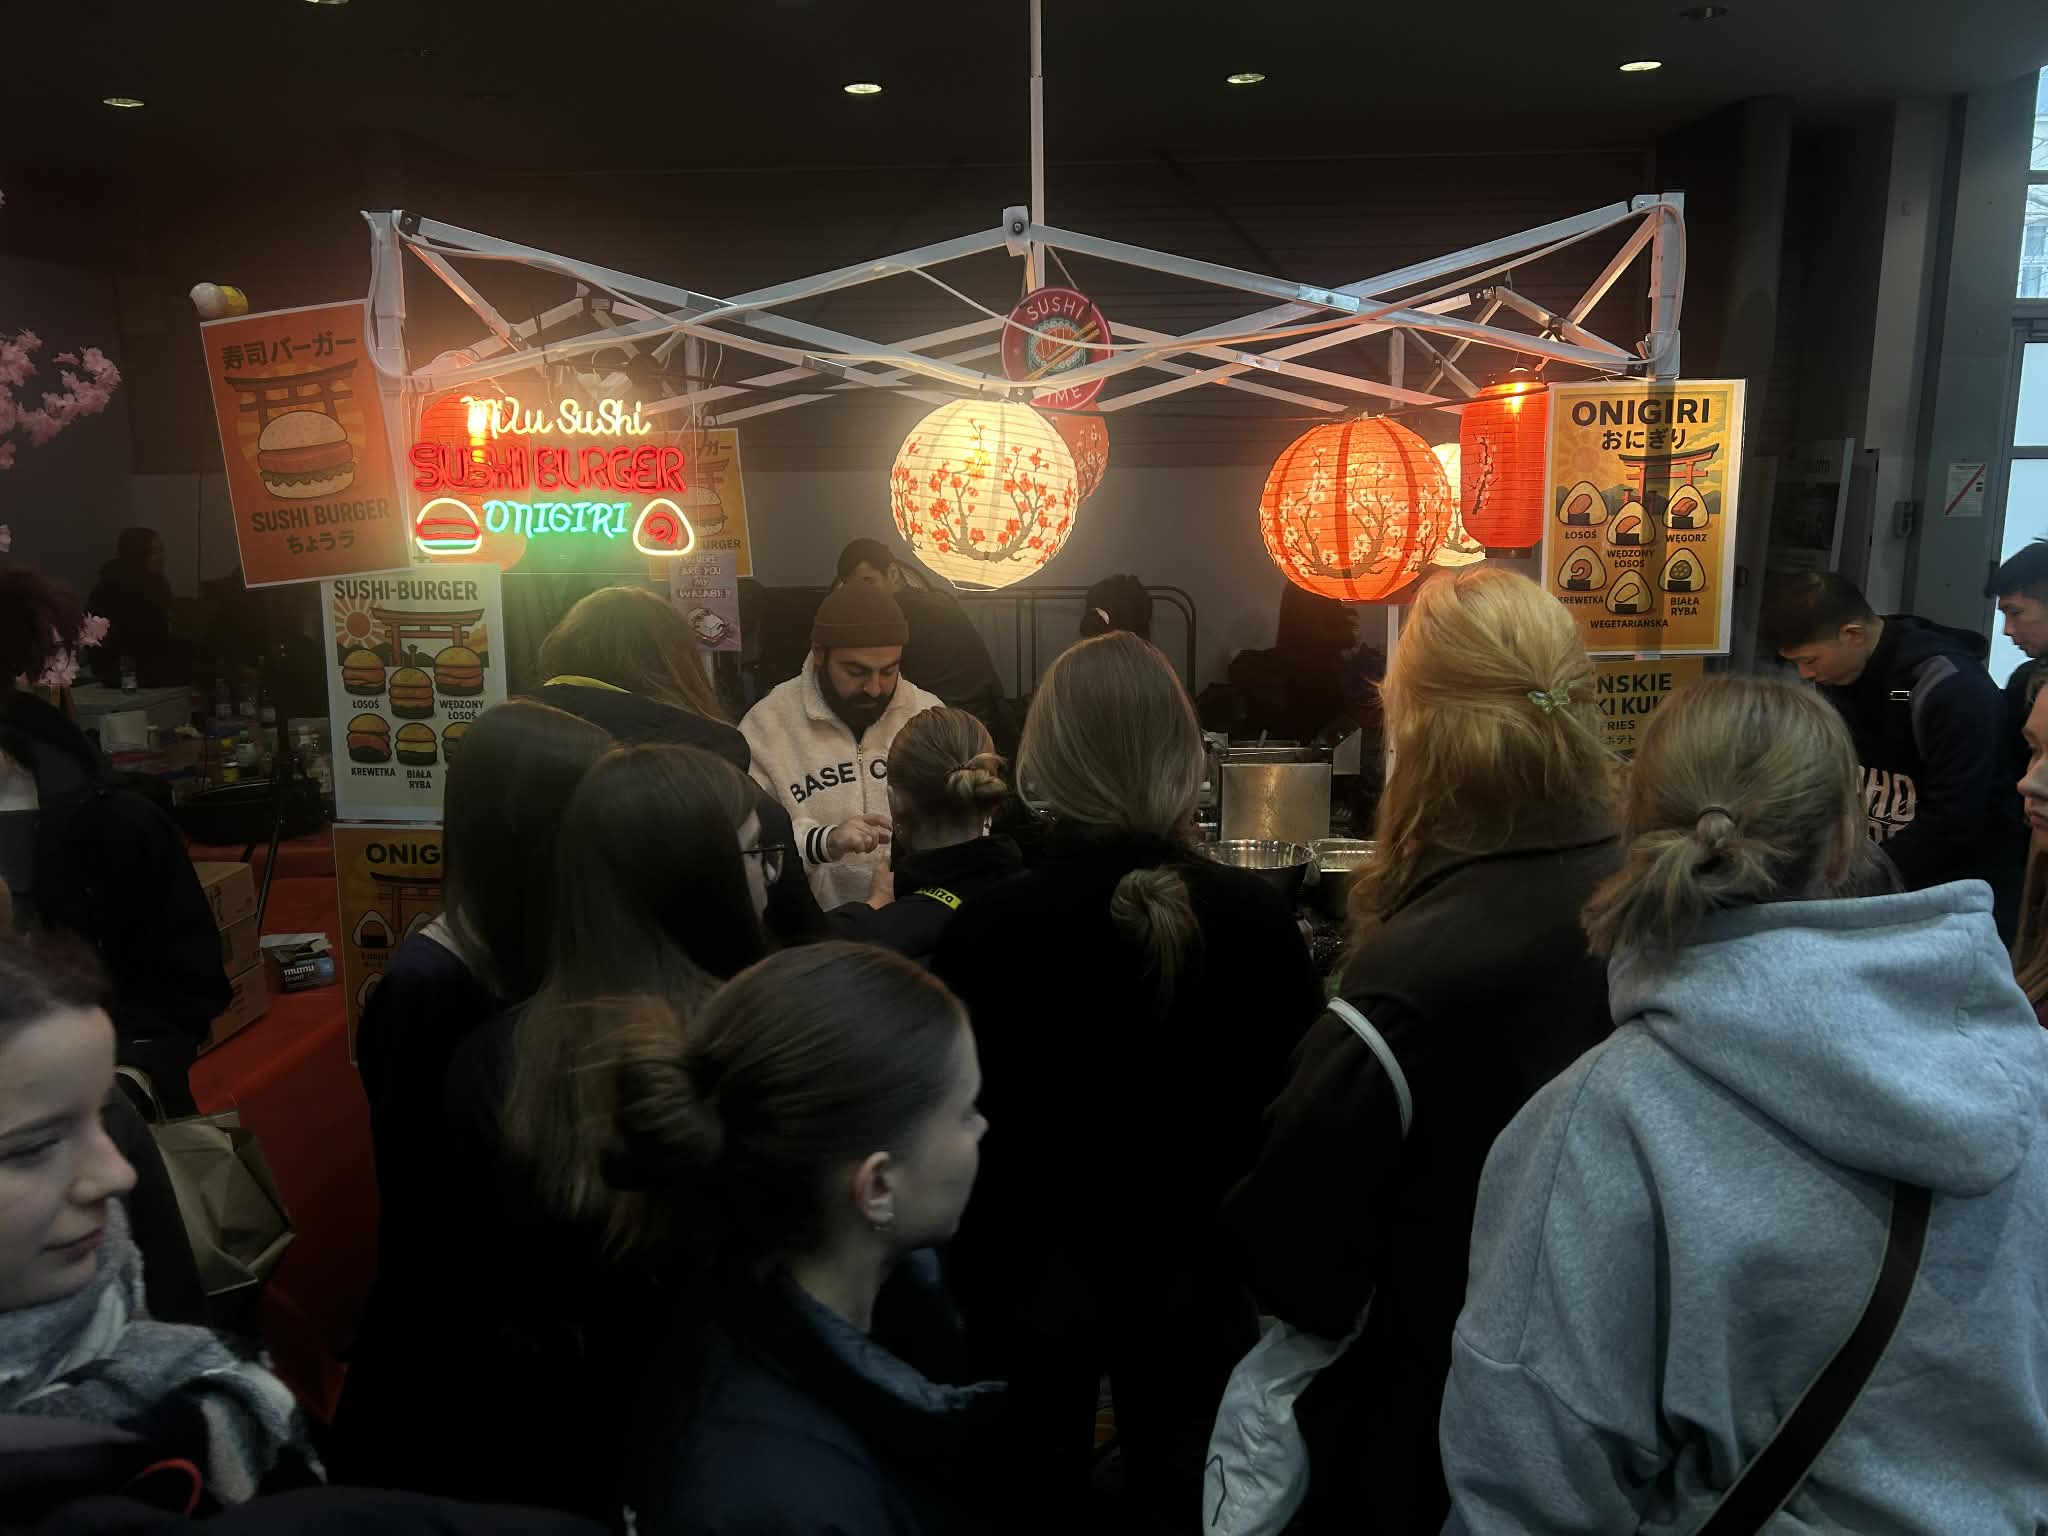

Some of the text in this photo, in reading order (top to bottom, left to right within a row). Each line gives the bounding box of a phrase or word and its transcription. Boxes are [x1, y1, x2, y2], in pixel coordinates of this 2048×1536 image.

[1026, 296, 1085, 321] SUSHI
[221, 330, 358, 371] 寿司バーガー
[1047, 387, 1082, 404] IME
[1571, 398, 1710, 426] ONIGIRI
[1601, 428, 1687, 451] おにぎり
[410, 443, 686, 493] SUSHI BURGER
[252, 498, 391, 534] SUSHI BURGER
[483, 500, 630, 538] ONIGIRI
[1665, 533, 1707, 545] WĘGORZ
[333, 579, 478, 601] SUSHI-BURGER
[1670, 607, 1697, 617] RYBA
[1597, 671, 1672, 694] ŃSKIE
[1607, 720, 1635, 731] RIES
[351, 767, 396, 777] KREWETKA
[789, 762, 856, 804] BASE
[409, 780, 432, 789] RYBA
[366, 843, 440, 865] ONIG
